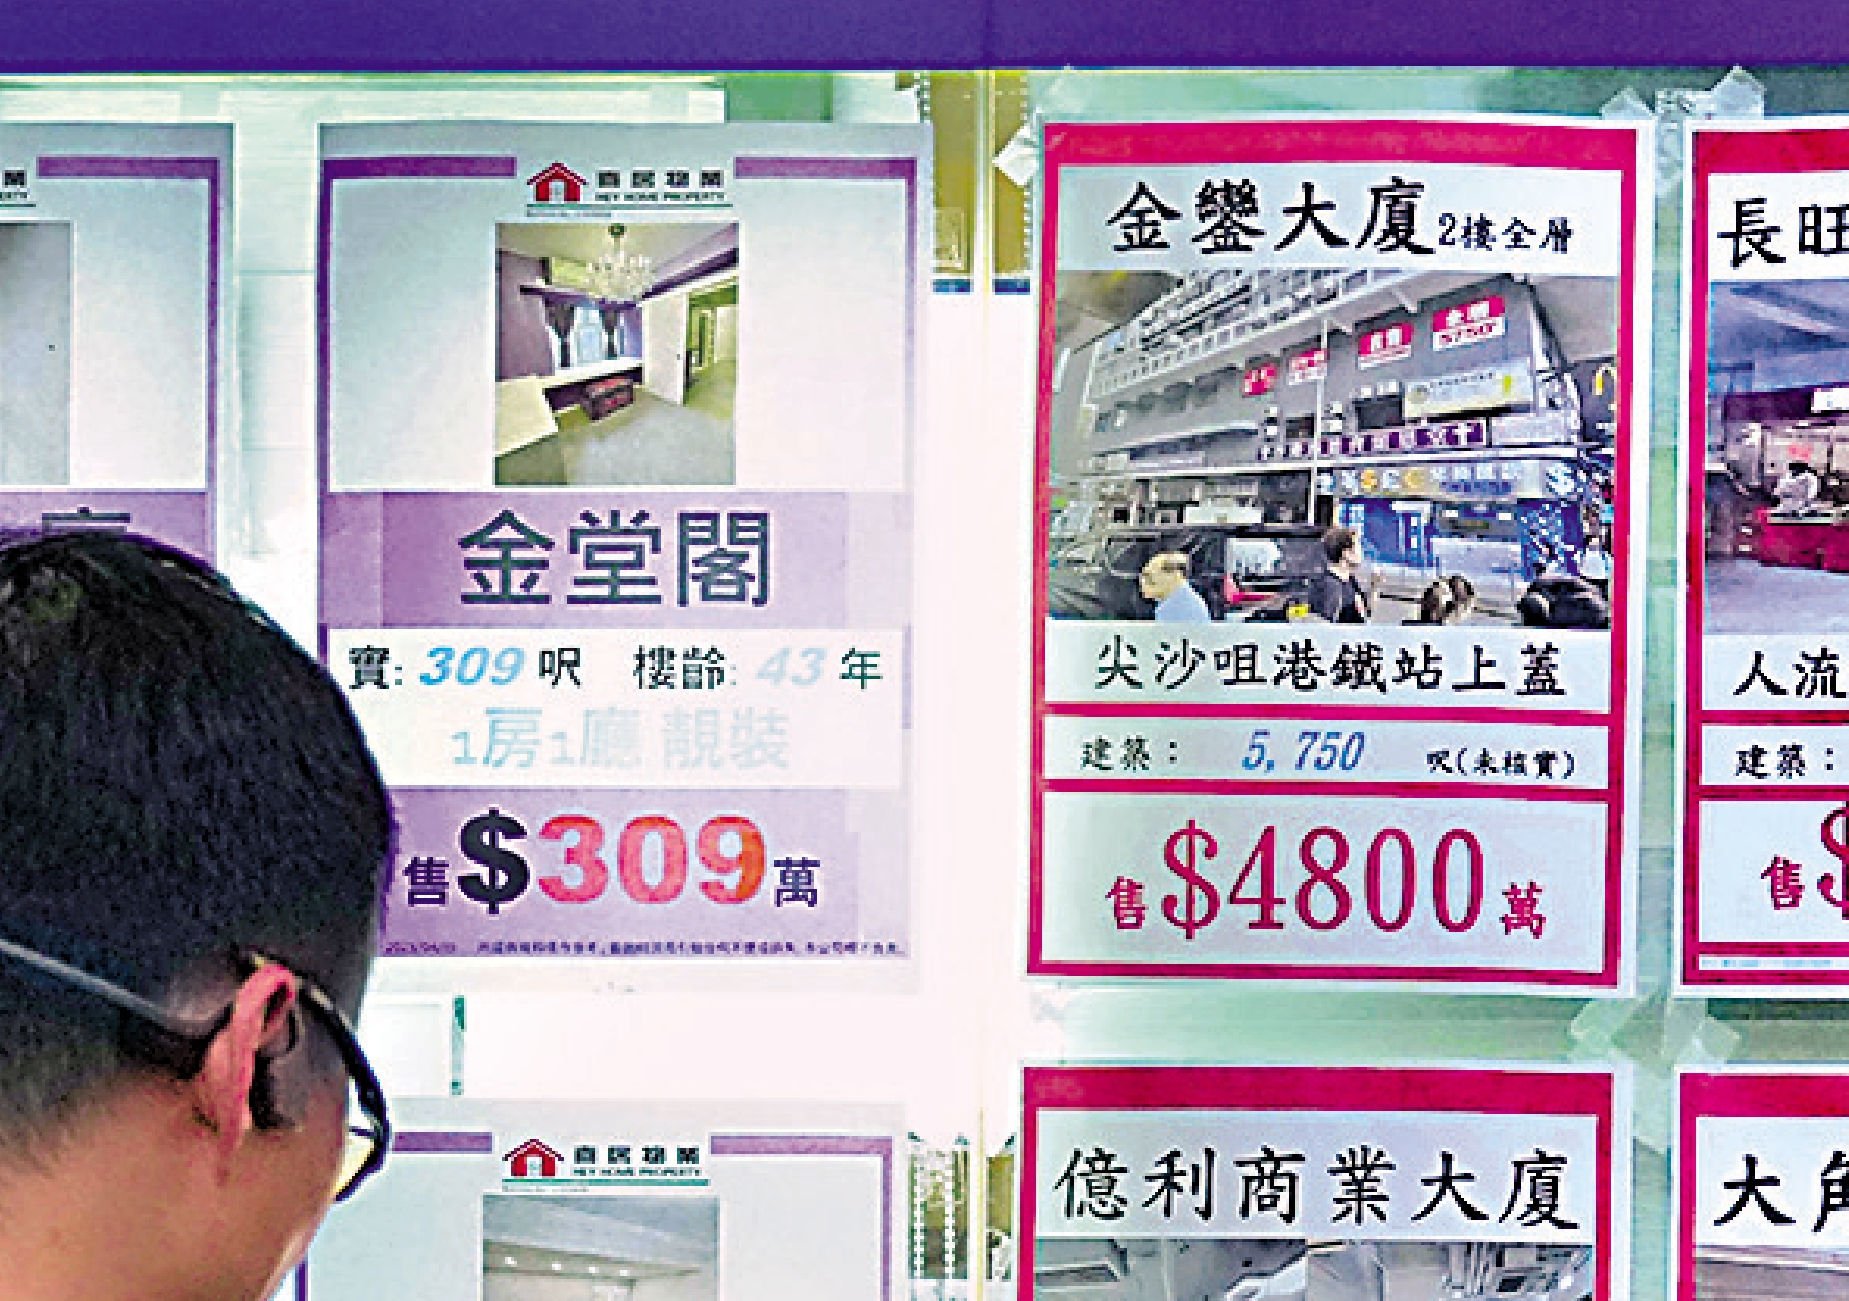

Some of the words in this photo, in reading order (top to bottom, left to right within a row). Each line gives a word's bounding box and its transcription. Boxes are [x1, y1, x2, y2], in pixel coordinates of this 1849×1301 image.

[458, 510, 770, 607] 金堂閣
[420, 647, 524, 685] 309
[539, 649, 582, 688] 呎
[756, 647, 828, 685] 43
[839, 649, 883, 690] 年
[1094, 636, 1567, 696] 尖沙咀港鐵站上蓋
[1240, 729, 1366, 772] 5,750
[1054, 1144, 1580, 1230] 億利商業大廈
